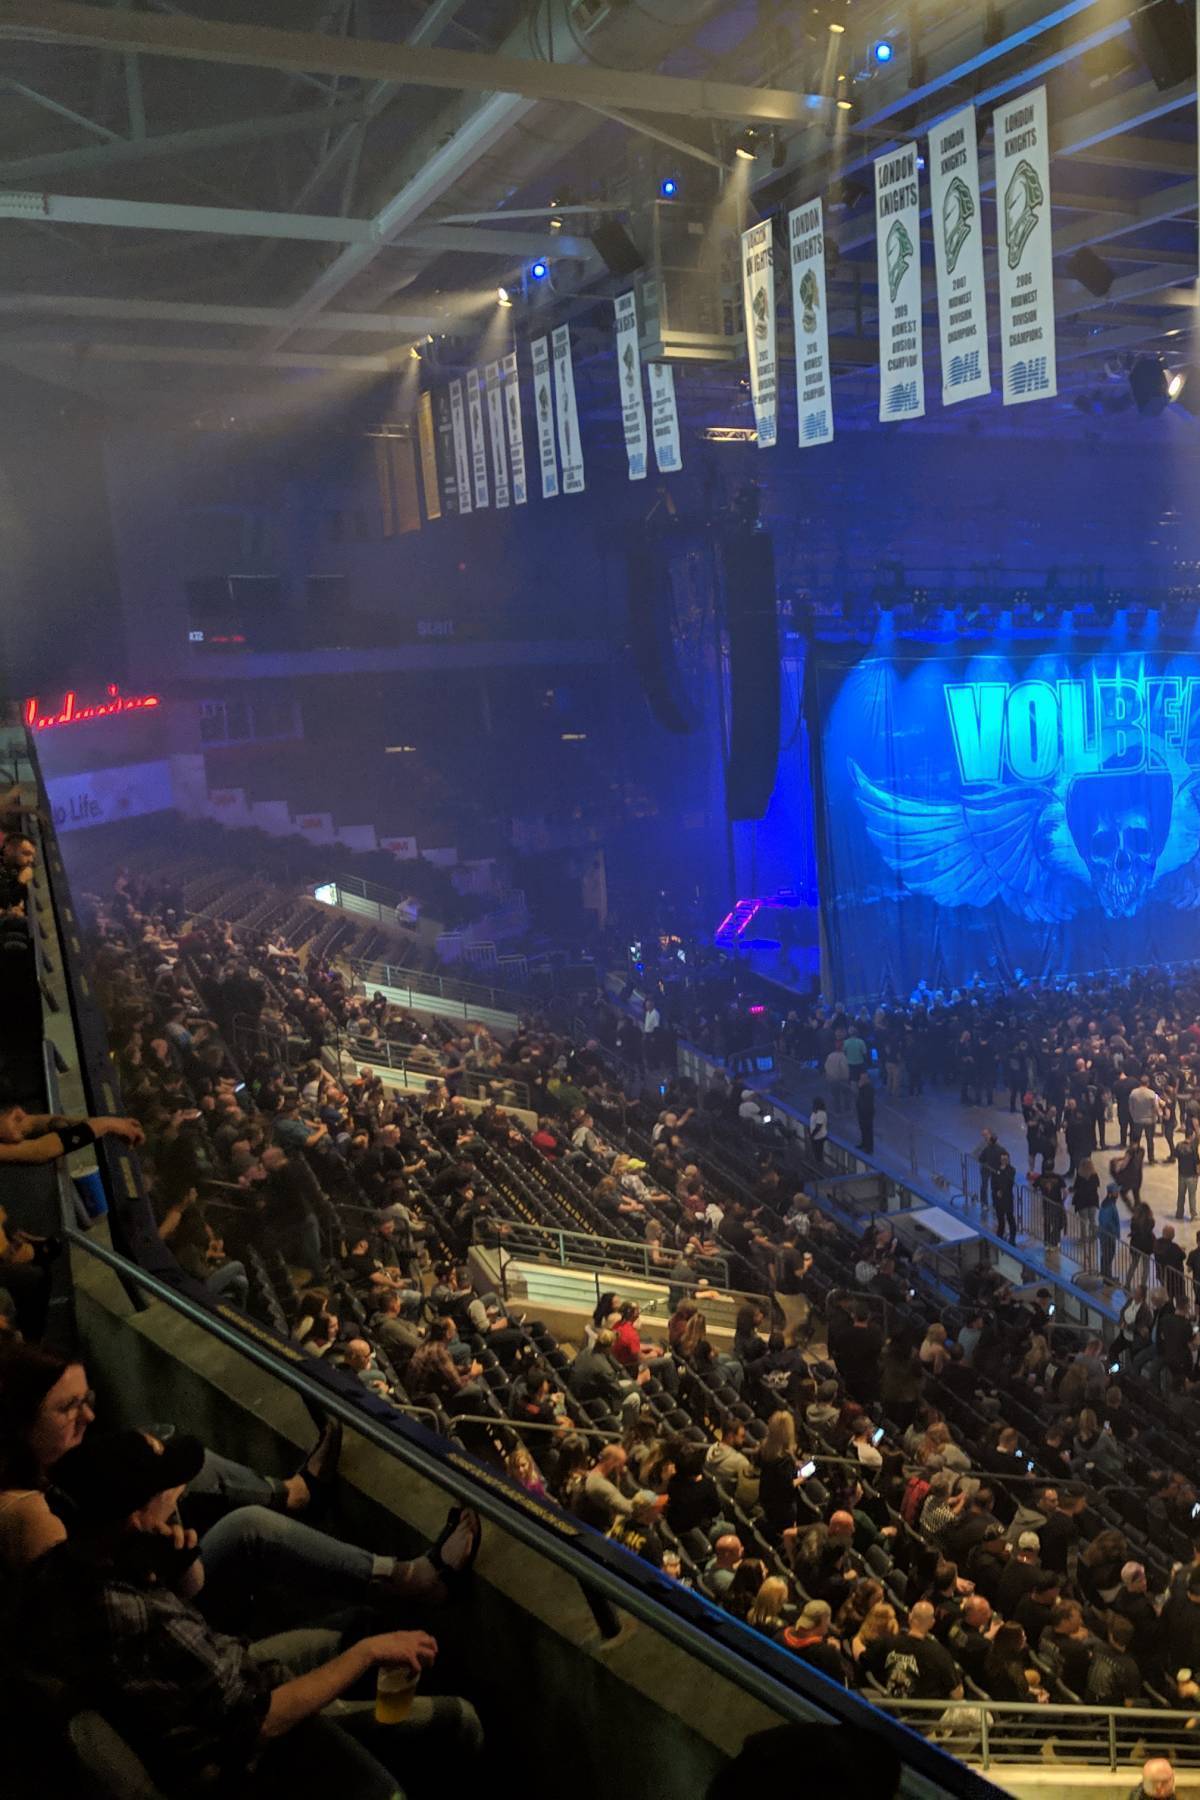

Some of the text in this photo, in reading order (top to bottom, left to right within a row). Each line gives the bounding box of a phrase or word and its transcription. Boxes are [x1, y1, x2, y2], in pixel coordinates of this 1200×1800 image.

[1005, 105, 1035, 134] LONDON
[940, 128, 965, 155] LONDON
[1005, 128, 1037, 157] KNIGHTS
[878, 153, 915, 189] LONDON
[941, 149, 967, 175] KNIGHTS
[879, 182, 918, 218] KNIGHTS
[792, 207, 820, 240] LONDON
[793, 233, 823, 265] KNIGHTS
[948, 291, 972, 309] MIDWEST
[1011, 289, 1038, 308] MIDWEST
[1012, 309, 1037, 327] DIVISION
[947, 325, 977, 344] CHAMPIONS
[1009, 327, 1043, 347] CHAMPIONS
[1008, 357, 1049, 395] OHL
